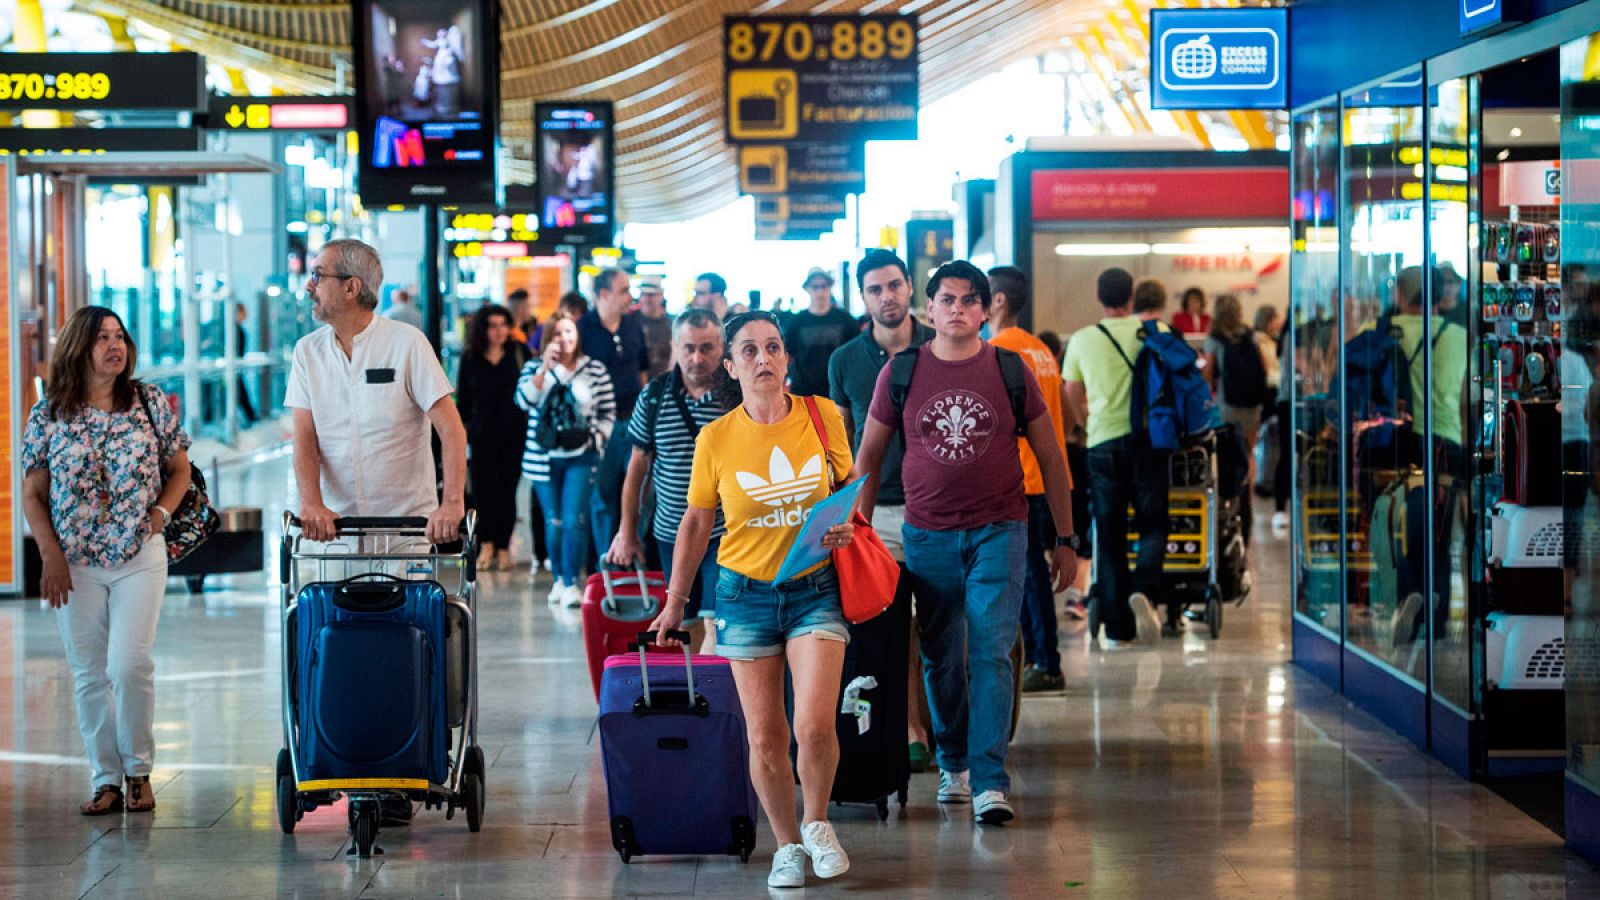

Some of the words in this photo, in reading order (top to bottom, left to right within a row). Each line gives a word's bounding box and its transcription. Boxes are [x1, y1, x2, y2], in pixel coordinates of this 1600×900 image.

[1221, 46, 1267, 56] EXCESS
[1221, 65, 1266, 75] COMPANY
[922, 395, 989, 423] FLORENCE
[933, 444, 975, 460] ITALY
[747, 504, 813, 528] adid
